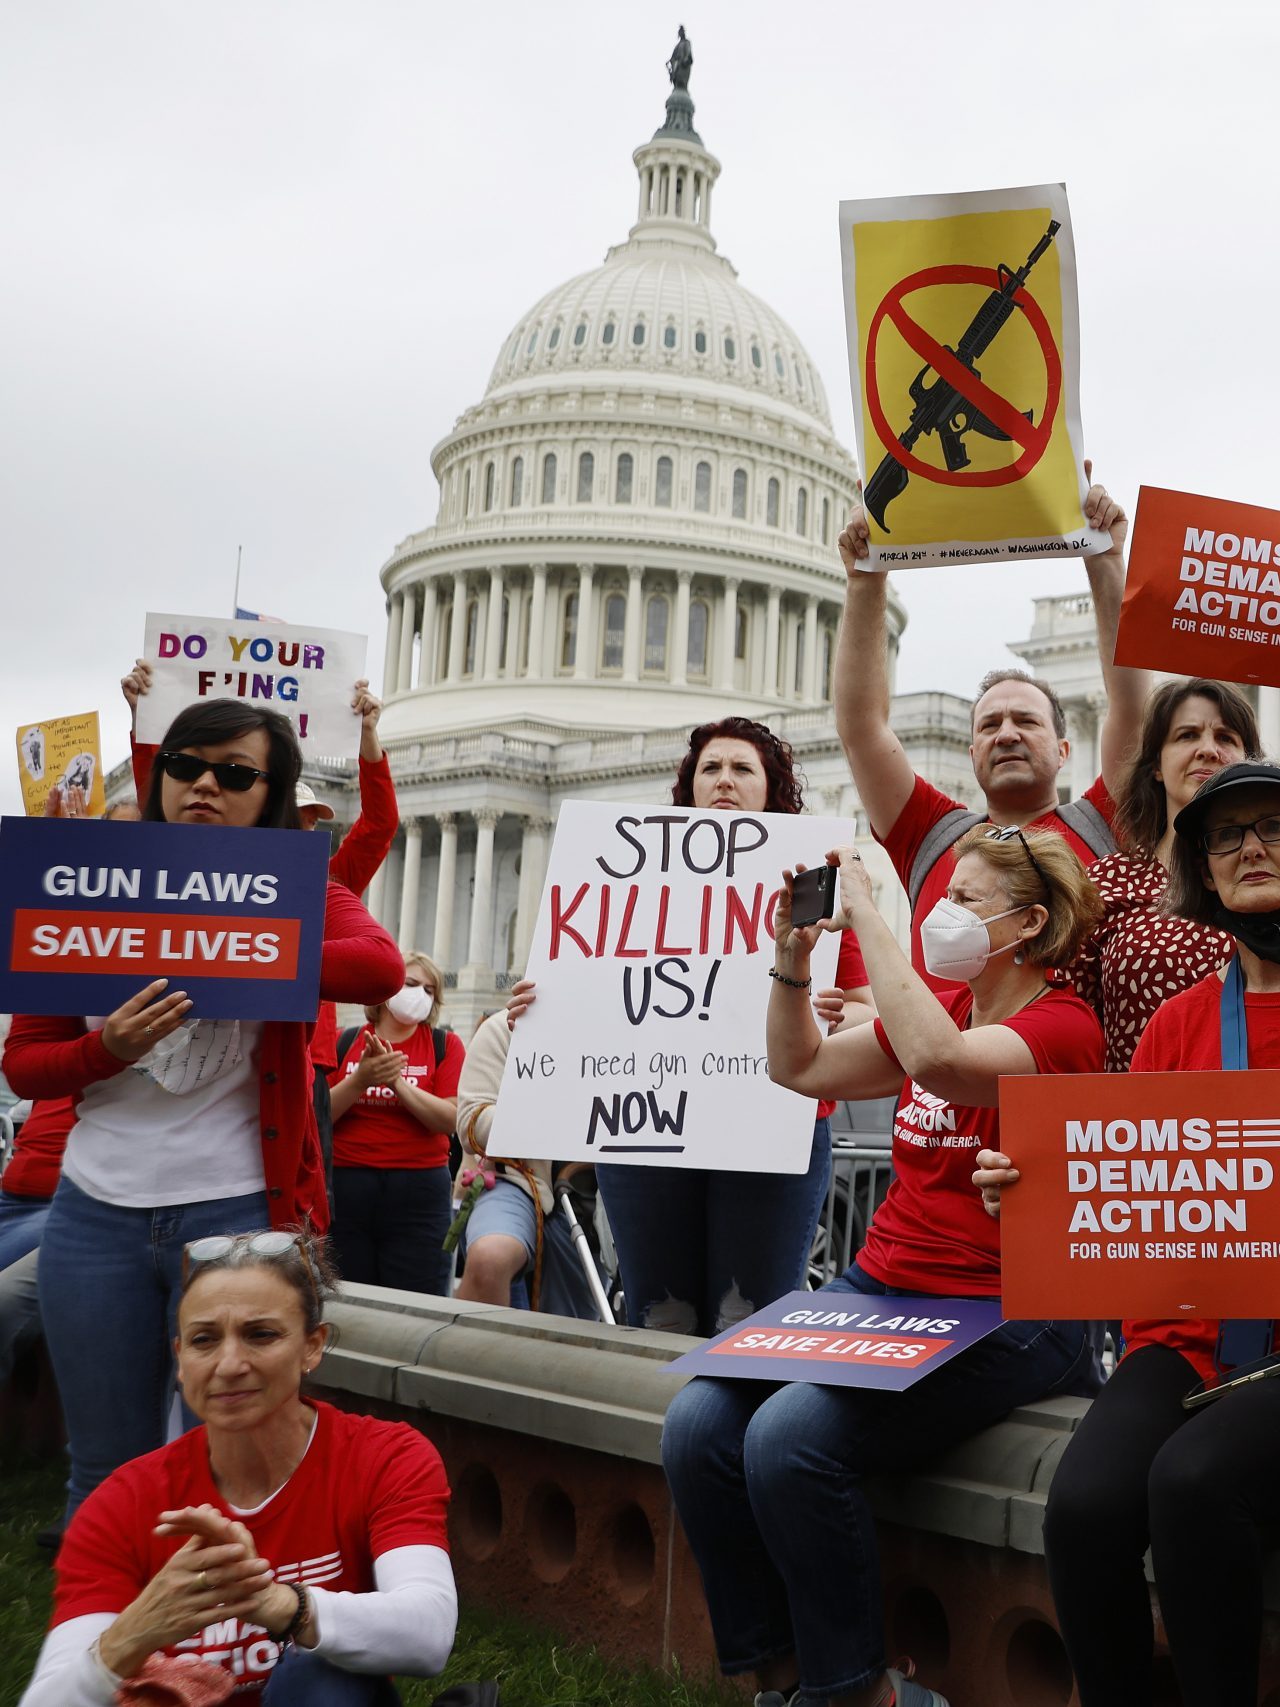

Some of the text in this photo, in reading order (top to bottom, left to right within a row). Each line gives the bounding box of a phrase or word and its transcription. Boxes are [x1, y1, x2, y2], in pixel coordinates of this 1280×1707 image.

[879, 551, 909, 562] MARCH
[939, 546, 1000, 558] #NEVERAGAIN
[1008, 541, 1069, 554] WASHINGTON
[1072, 538, 1092, 550] D.C.
[1171, 617, 1197, 633] FOR
[1200, 622, 1226, 638] GUN
[1229, 627, 1269, 645] SENSE
[158, 633, 325, 670] DO YOUR
[596, 815, 769, 880] STOP
[43, 865, 279, 905] GUN LAWS
[31, 924, 281, 963] SAVE LIVES
[623, 957, 722, 1026] US!
[580, 1051, 636, 1079] need
[649, 1051, 688, 1090] gun
[701, 1051, 770, 1077] contr
[586, 1089, 688, 1145] NOW
[896, 1101, 957, 1132] ACTION
[928, 1137, 941, 1148] IN
[942, 1135, 982, 1148] AMERICA
[1065, 1118, 1212, 1153] MOMS
[1067, 1158, 1274, 1193] DEMAND
[1068, 1199, 1247, 1233] ACTION
[1070, 1243, 1101, 1260] FOR
[1106, 1242, 1140, 1260] GUN
[1144, 1242, 1197, 1260] SENSE
[1201, 1242, 1218, 1259] IN
[781, 1310, 961, 1335] GUN LAWS
[733, 1333, 927, 1360] SAVE LIVES
